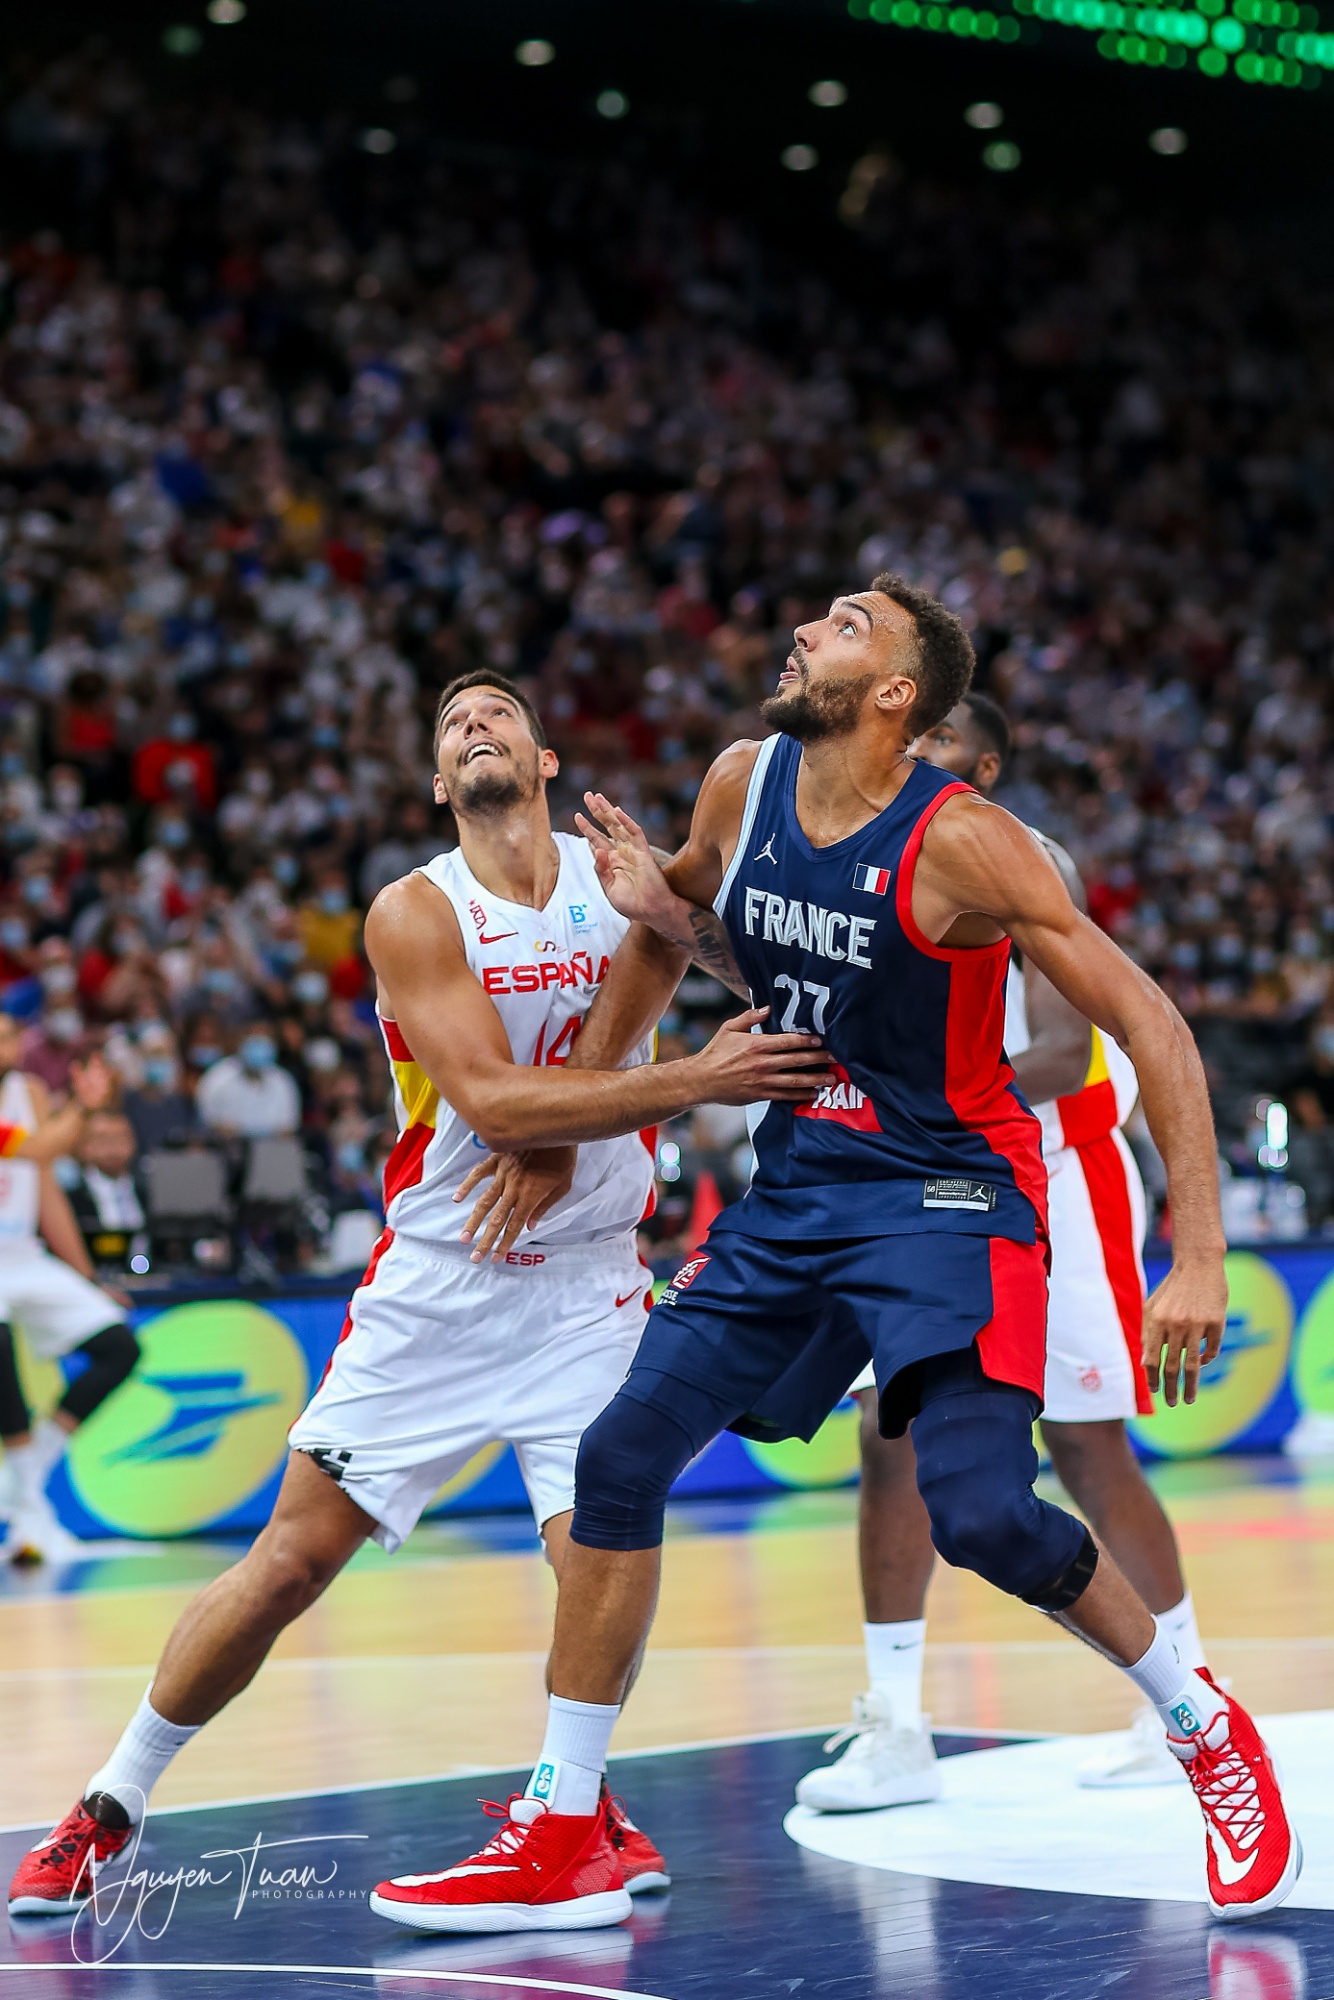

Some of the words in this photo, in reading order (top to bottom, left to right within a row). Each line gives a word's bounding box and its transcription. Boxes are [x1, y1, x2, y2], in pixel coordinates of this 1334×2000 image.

[745, 886, 877, 969] FRANCE
[774, 973, 830, 1035] 27
[505, 1252, 545, 1266] ESP
